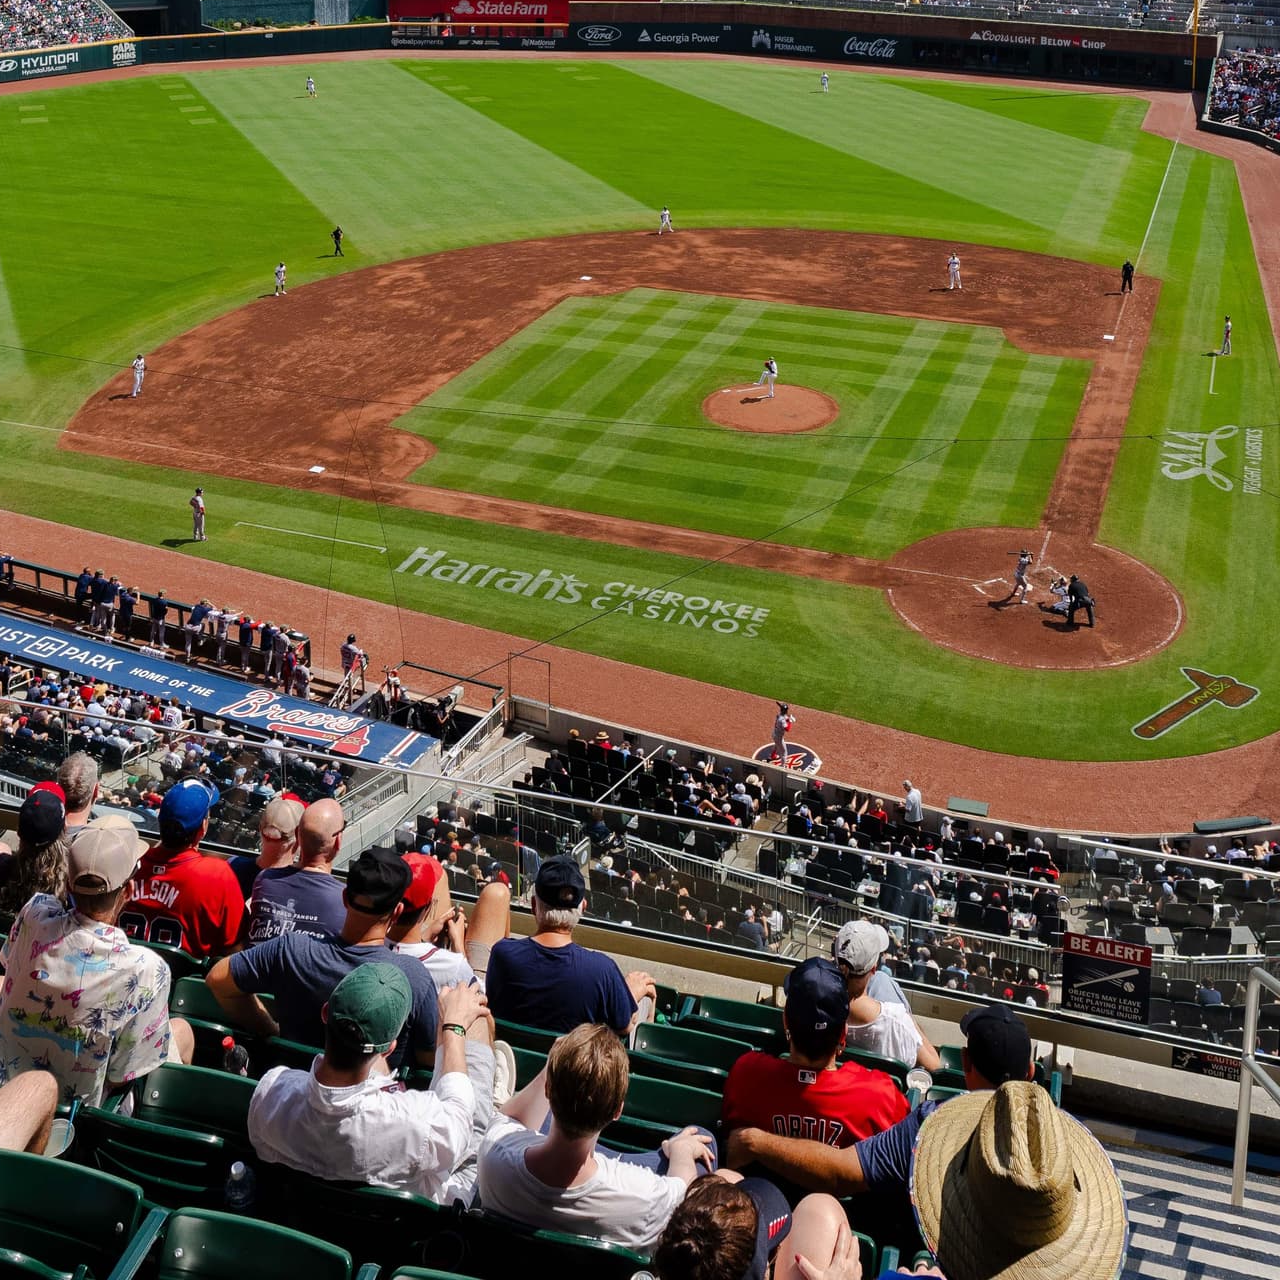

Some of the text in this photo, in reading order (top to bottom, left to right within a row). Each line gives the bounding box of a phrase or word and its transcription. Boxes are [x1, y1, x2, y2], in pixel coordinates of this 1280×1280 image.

[529, 38, 556, 47] National
[585, 27, 614, 40] Ford
[653, 32, 720, 45] Georgia Power
[774, 35, 795, 44] KAISER
[1010, 34, 1106, 50] LIGHT BELOW CHOP
[112, 43, 137, 55] PAPA
[21, 52, 79, 69] HYUNDAI
[1249, 428, 1264, 462] LOGISTICS
[394, 545, 771, 622] Harrah's CHEROKEE
[591, 595, 761, 639] CASINOS
[59, 645, 124, 673] PARK
[129, 667, 167, 685] HOME
[169, 678, 188, 689] OF
[187, 684, 215, 698] THE
[216, 689, 371, 732] Braves
[1070, 936, 1145, 963] BE ALERT
[1068, 987, 1142, 1009] OBJECTS MAY LEAVE
[1070, 994, 1140, 1015] THE PLAYING FIELD
[1074, 1002, 1143, 1022] MAY CAUSE INJURY
